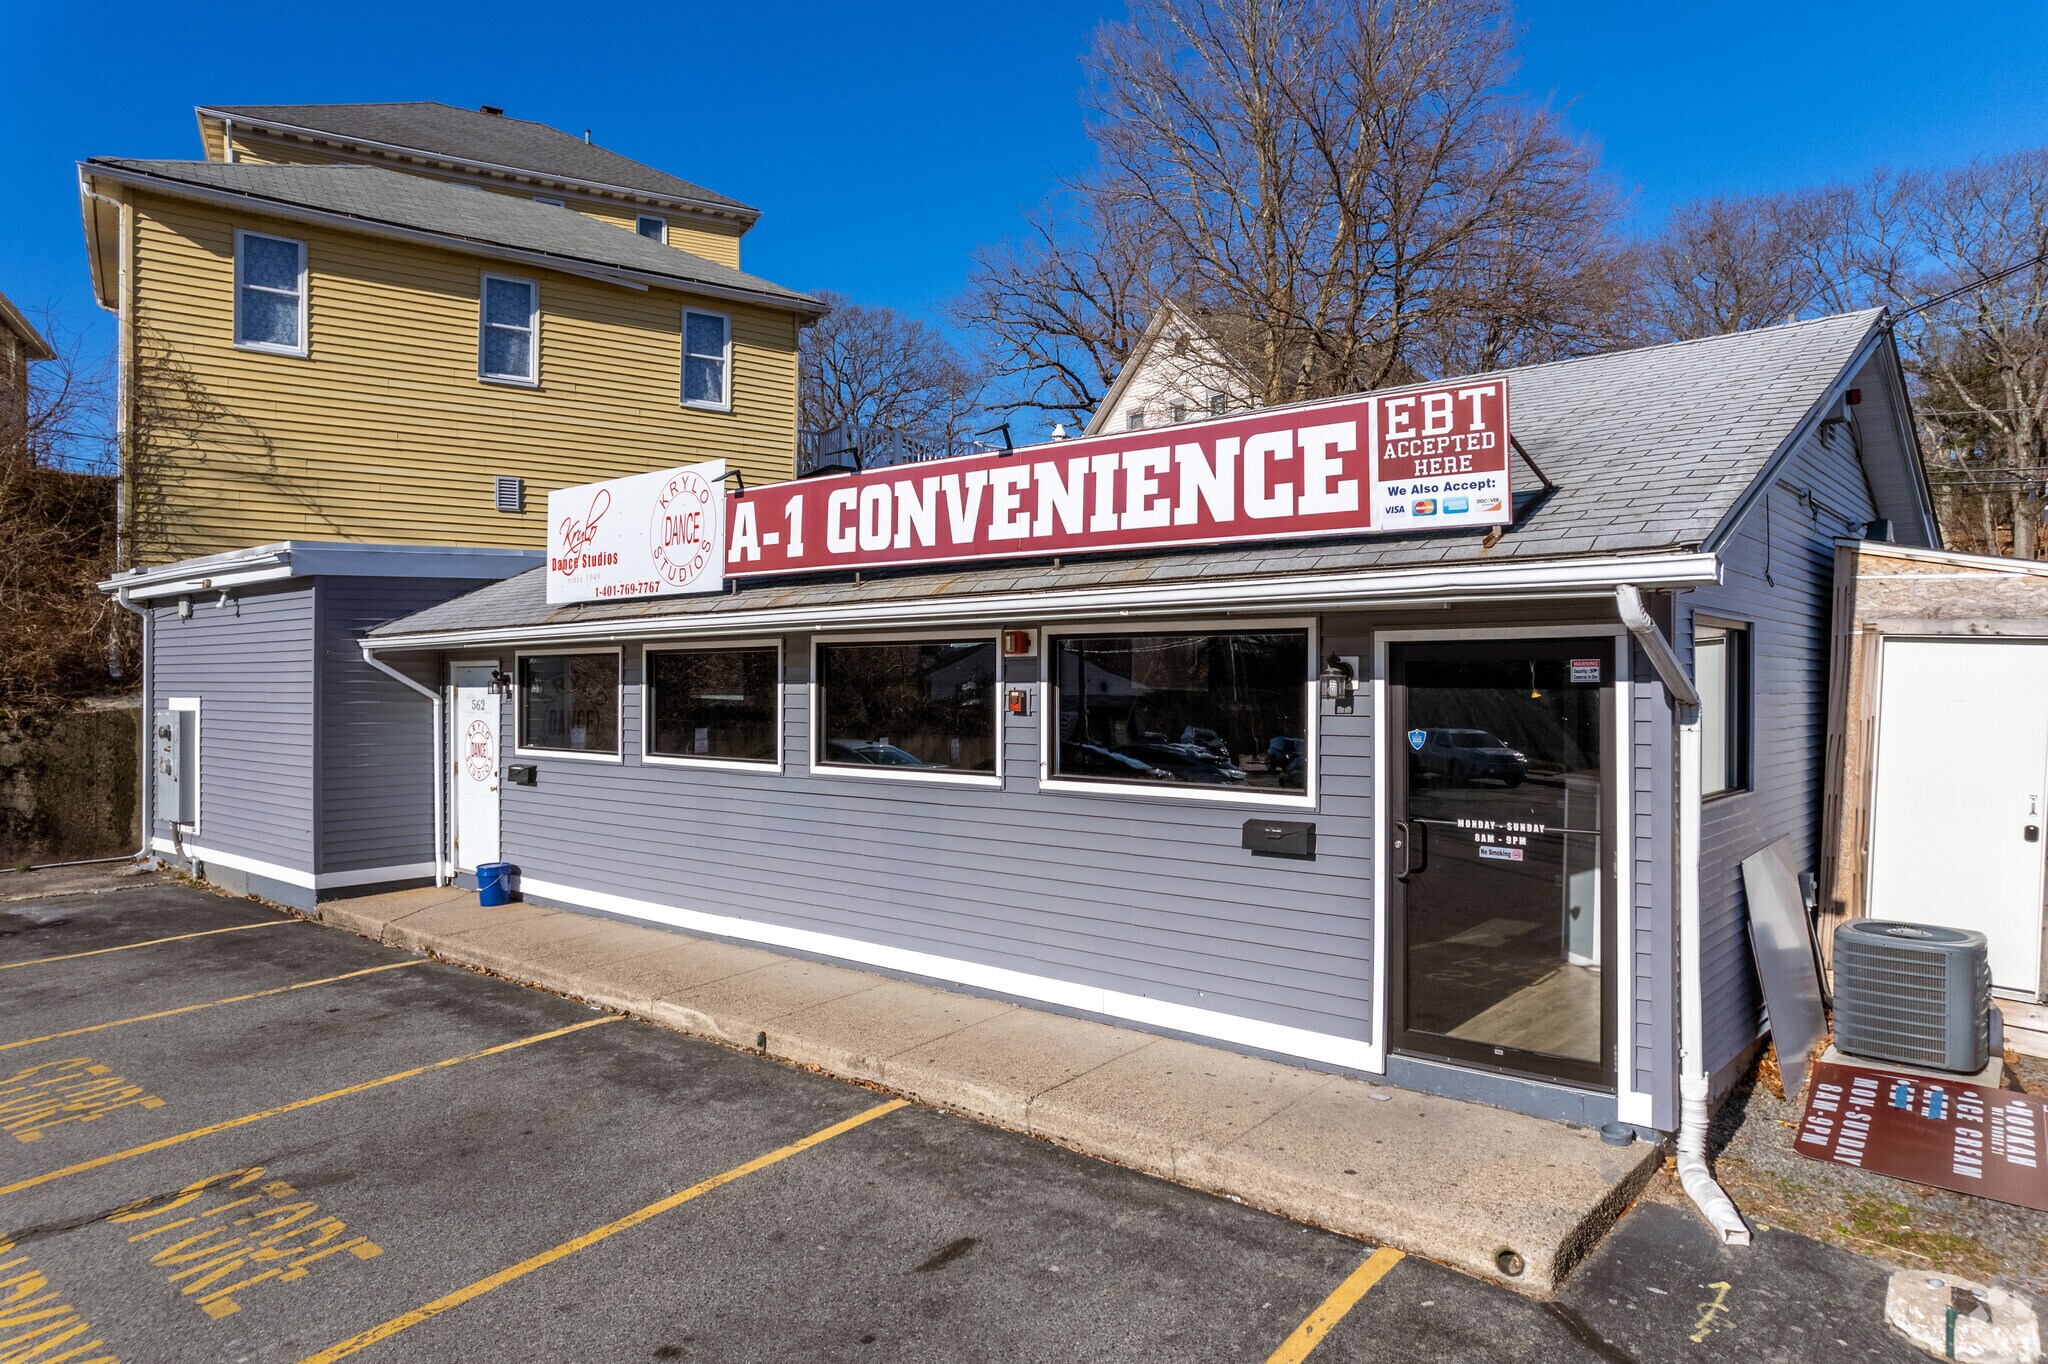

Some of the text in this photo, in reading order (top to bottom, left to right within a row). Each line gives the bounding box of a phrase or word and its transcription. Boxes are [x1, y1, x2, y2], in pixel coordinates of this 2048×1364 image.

[1385, 386, 1496, 440] EBT
[1384, 432, 1495, 459] ACCEPTED
[1414, 454, 1472, 476] HERE
[659, 476, 709, 509] KRYLO
[728, 421, 1358, 562] A-1 CONVENIENCE
[1388, 478, 1496, 496] We Also Accept:
[1385, 505, 1405, 514] VISA
[665, 511, 700, 547] DANCE
[552, 551, 618, 572] Dance Studios
[654, 539, 711, 583] STUDIOS
[567, 574, 584, 583] since
[595, 581, 661, 598] 1-401-769-7767
[471, 699, 486, 711] 562
[468, 721, 490, 740] KRYLO
[470, 742, 487, 758] DANCE
[1457, 819, 1495, 830] MONDAY
[1507, 822, 1545, 833] SUNDAY
[1474, 833, 1495, 843] 8AM
[1506, 836, 1527, 846] 9PM
[1488, 849, 1511, 858] Smoking
[1801, 1083, 1843, 1146] 8AM-9PM
[1833, 1077, 1879, 1167] MON-SUNDAY
[1952, 1096, 1984, 1179] ICE CREAM
[2005, 1105, 2037, 1168] HOOKAH
